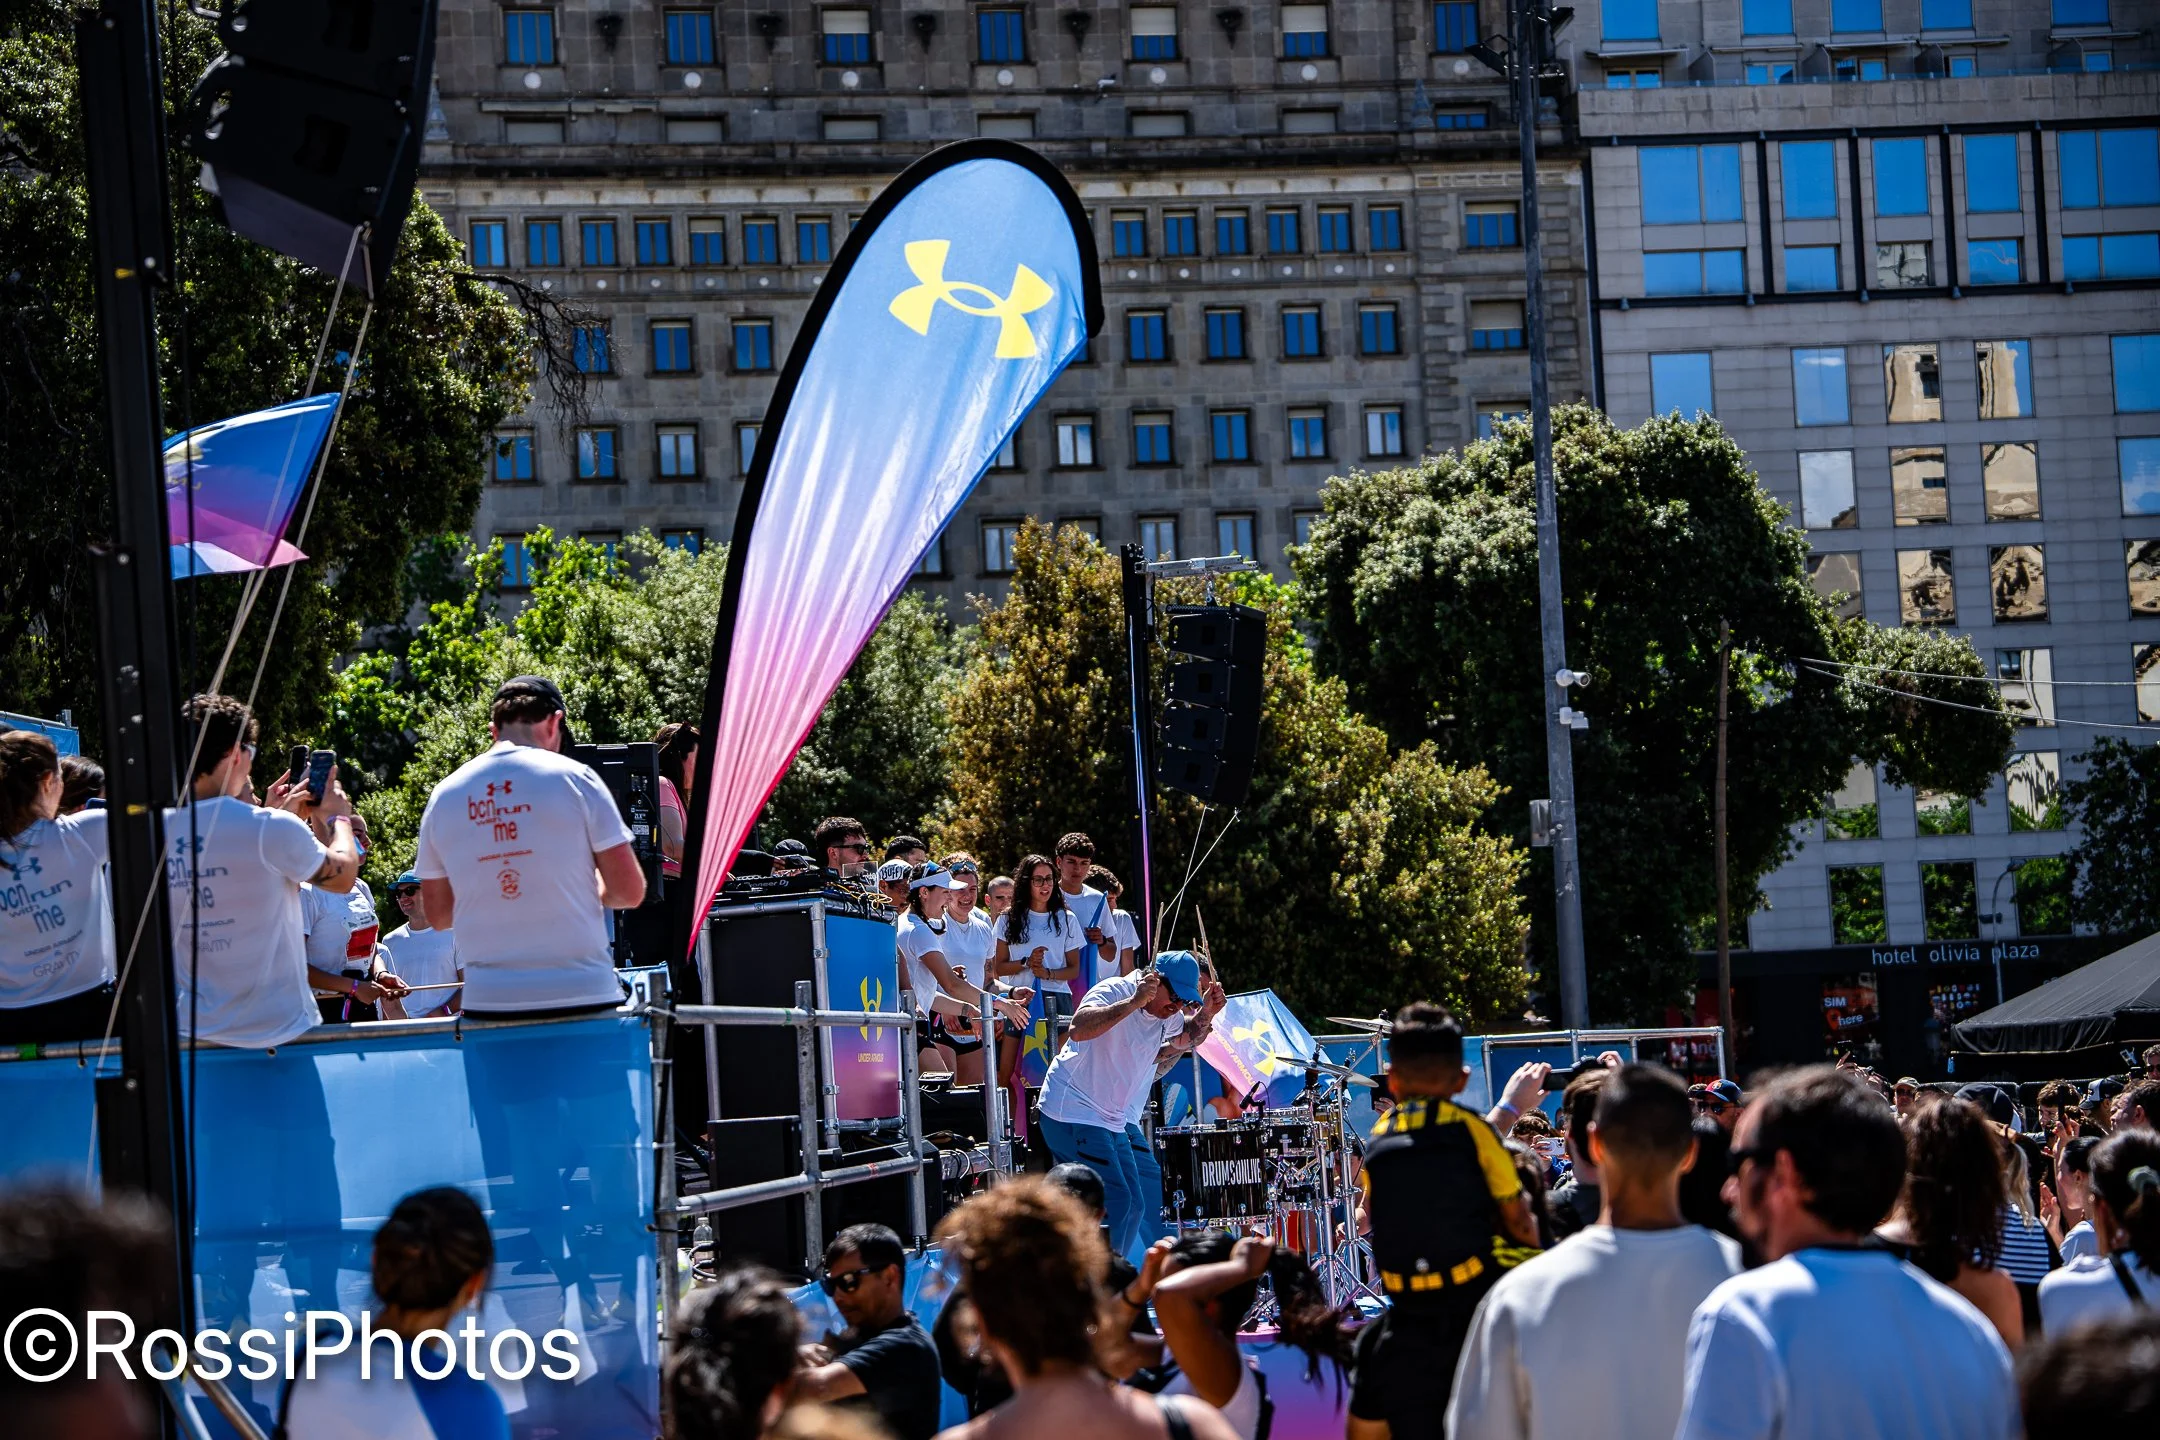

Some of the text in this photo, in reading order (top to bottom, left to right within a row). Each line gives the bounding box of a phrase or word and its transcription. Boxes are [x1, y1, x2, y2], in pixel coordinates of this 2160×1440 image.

[468, 795, 532, 820] bcn run
[494, 820, 518, 842] me
[166, 857, 187, 880] cn
[30, 880, 73, 902] run
[33, 904, 66, 934] me
[1872, 942, 2040, 965] hotel olivia plaza
[1823, 996, 1847, 1008] SIM
[1838, 1014, 1864, 1026] here
[1231, 1054, 1256, 1088] ARMOU
